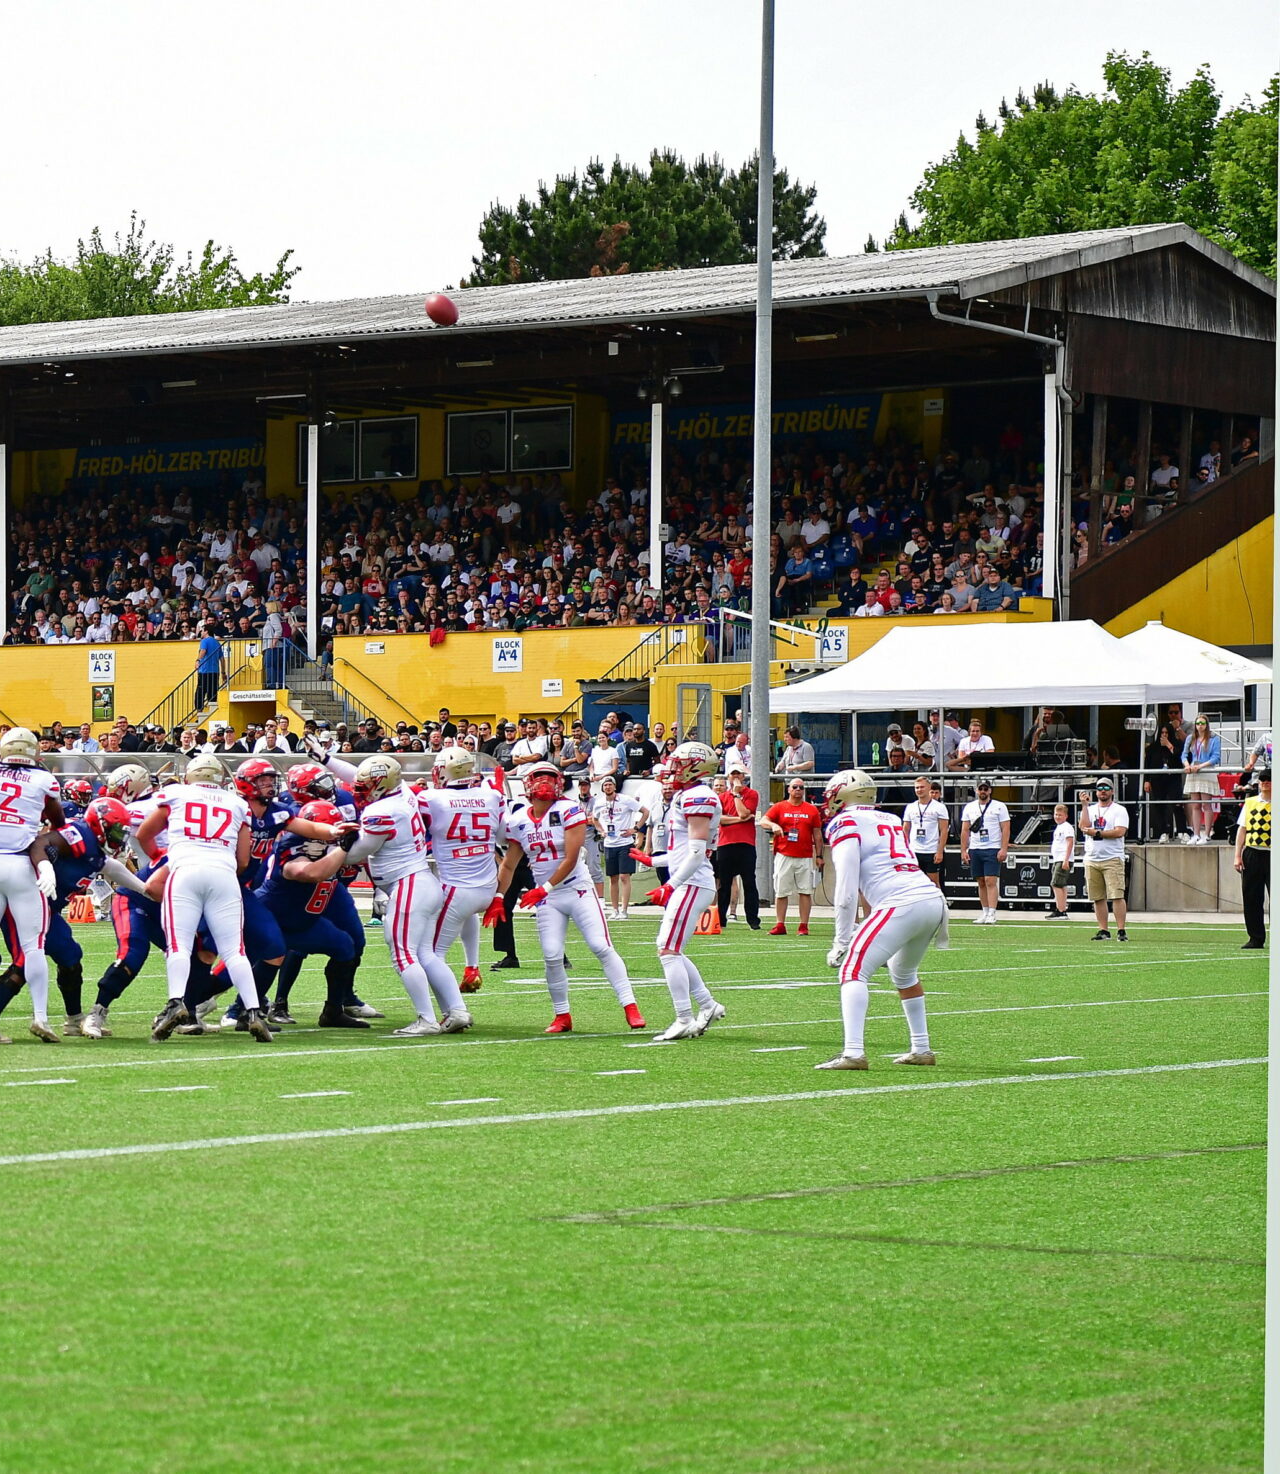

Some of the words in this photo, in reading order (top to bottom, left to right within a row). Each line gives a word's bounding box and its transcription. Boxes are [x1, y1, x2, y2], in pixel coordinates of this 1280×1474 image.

[77, 442, 267, 478] FRED-HÖLZER-TRIBÜ
[1029, 556, 1043, 573] 11
[823, 629, 845, 638] LOCK
[494, 640, 520, 649] BLOCK
[822, 638, 831, 651] A
[834, 638, 842, 651] 5
[90, 652, 113, 660] BLOCK
[497, 650, 507, 662] A
[509, 650, 518, 662] 4
[93, 661, 102, 672] A
[104, 661, 111, 672] 3
[449, 798, 486, 808] KITCHENS
[447, 812, 491, 843] 45
[527, 830, 554, 843] BERLIN
[877, 824, 916, 859] 27
[529, 840, 558, 862] 21
[70, 898, 85, 920] 30
